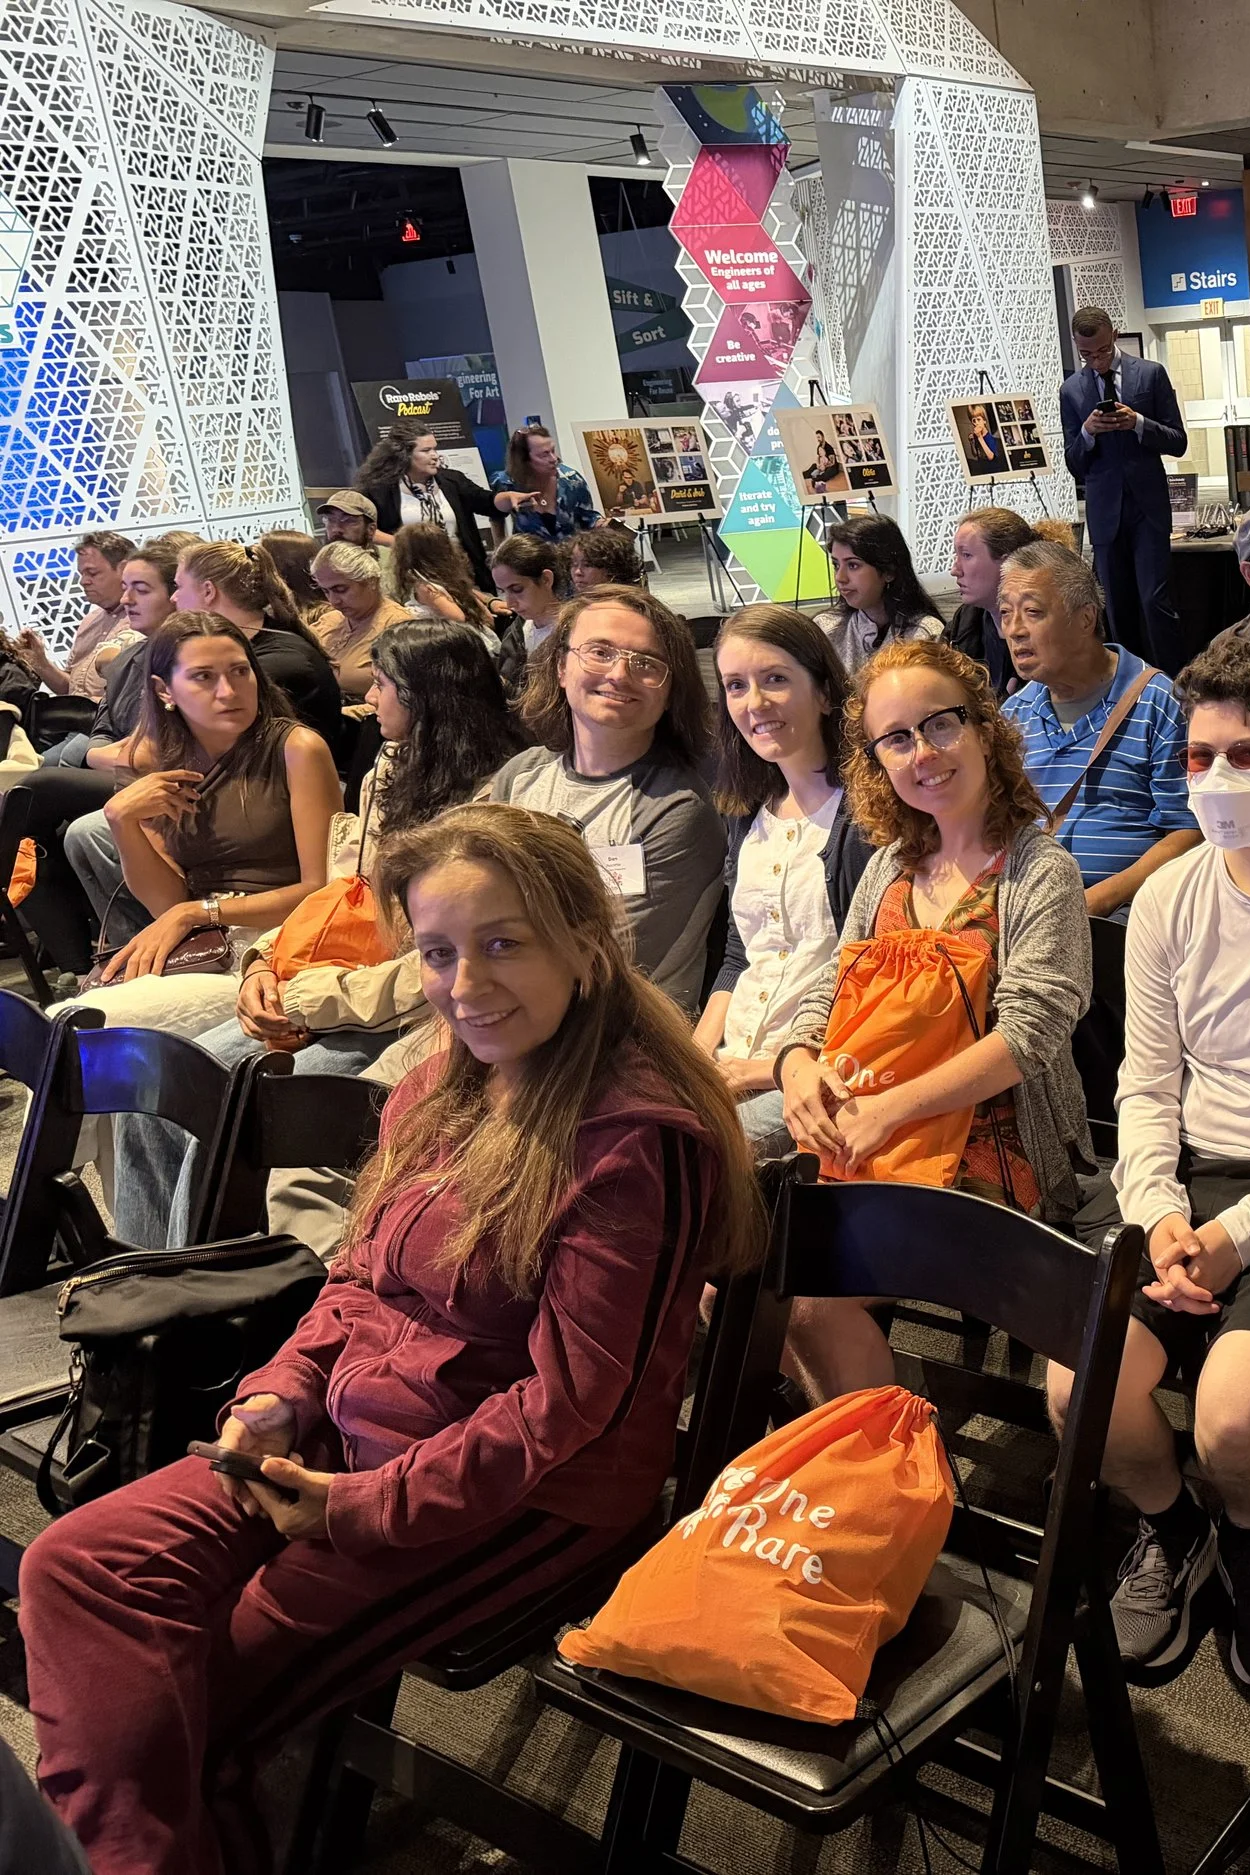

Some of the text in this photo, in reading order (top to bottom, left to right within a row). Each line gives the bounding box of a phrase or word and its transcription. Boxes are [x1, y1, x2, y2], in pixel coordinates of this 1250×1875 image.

[1177, 198, 1191, 214] EXIT
[704, 249, 778, 264] Welcome
[711, 265, 775, 279] Engineers of
[726, 280, 766, 292] all ages
[1189, 270, 1237, 289] Stairs
[613, 290, 653, 307] Sift &
[1204, 301, 1219, 315] EXIT
[632, 326, 666, 345] Sort
[727, 340, 740, 350] Be
[715, 352, 756, 363] creative
[447, 371, 497, 388] gineering
[385, 391, 440, 403] Rare Rebels
[469, 386, 499, 400] For Art
[397, 401, 433, 417] Podcast
[739, 490, 772, 501] Iterate
[740, 503, 775, 513] and try
[747, 514, 775, 526] again
[1216, 819, 1235, 830] 3M
[834, 1053, 896, 1089] One
[752, 1477, 836, 1529] One
[722, 1503, 823, 1584] Rare
